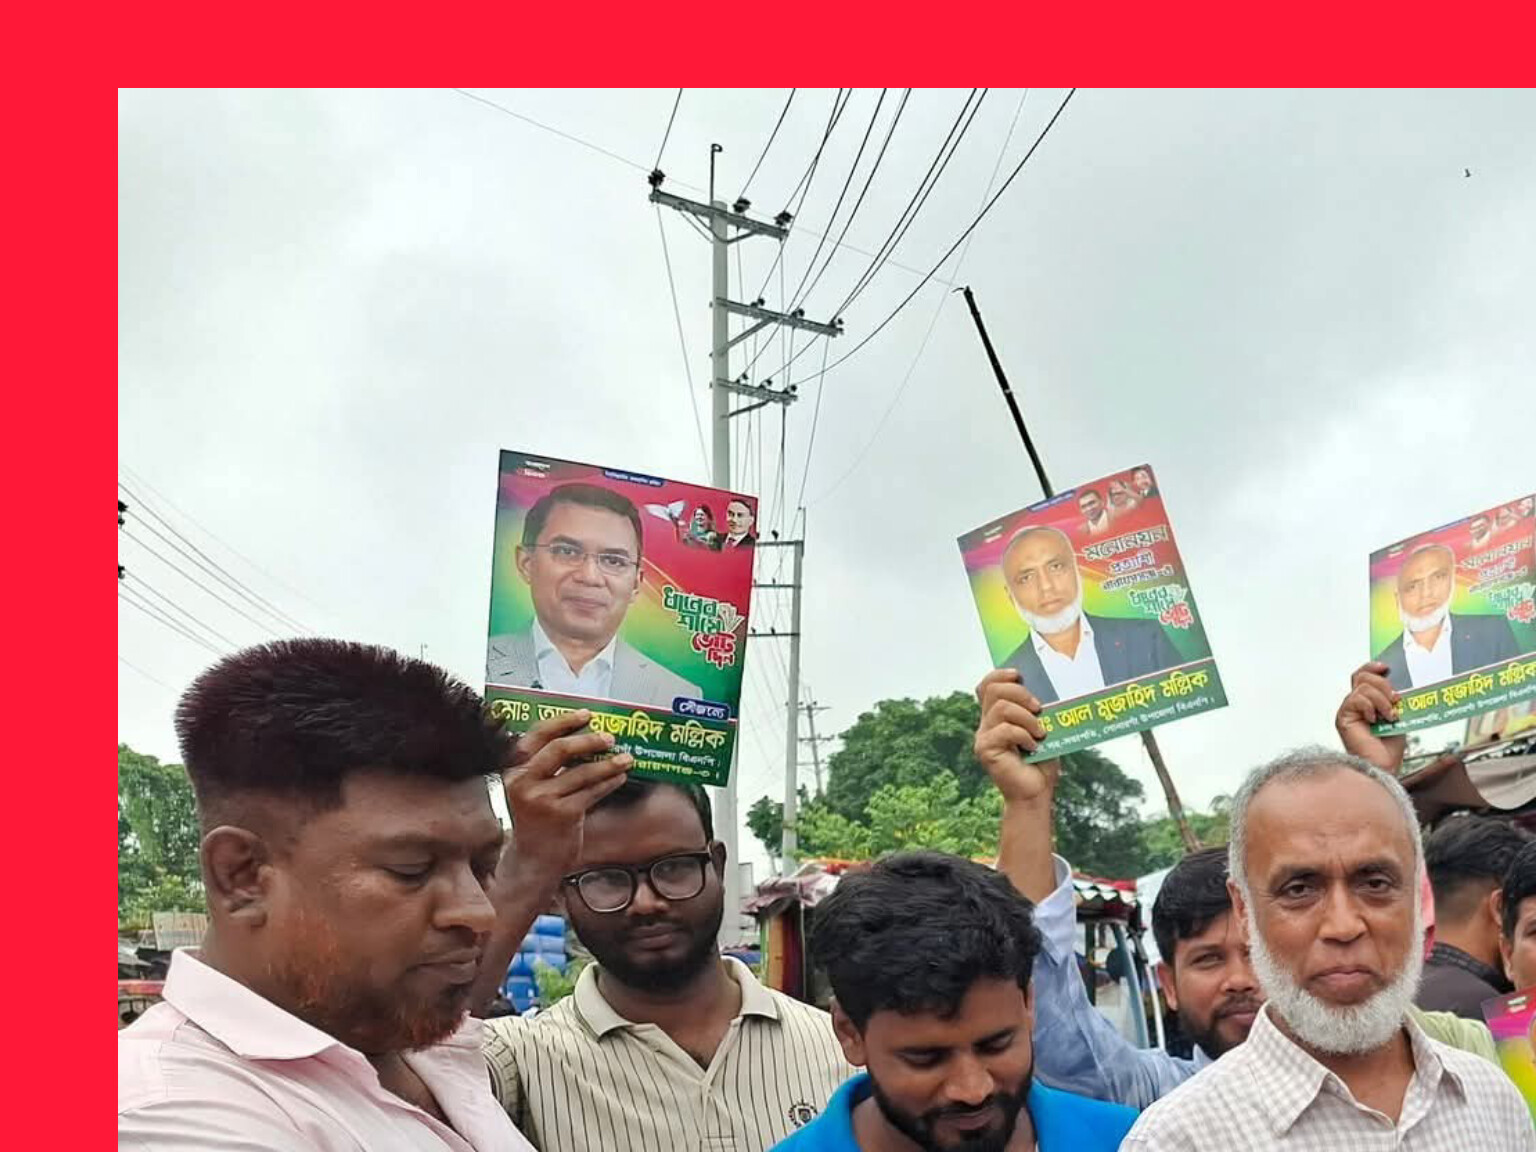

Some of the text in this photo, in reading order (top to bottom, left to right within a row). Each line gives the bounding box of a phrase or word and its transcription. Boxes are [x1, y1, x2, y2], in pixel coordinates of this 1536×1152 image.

[1056, 704, 1093, 728] আল
[1097, 683, 1156, 723] মুজাহিদ
[1160, 670, 1208, 698] মল্লিক
[1407, 691, 1438, 710] আল
[670, 719, 728, 750] মল্লিক
